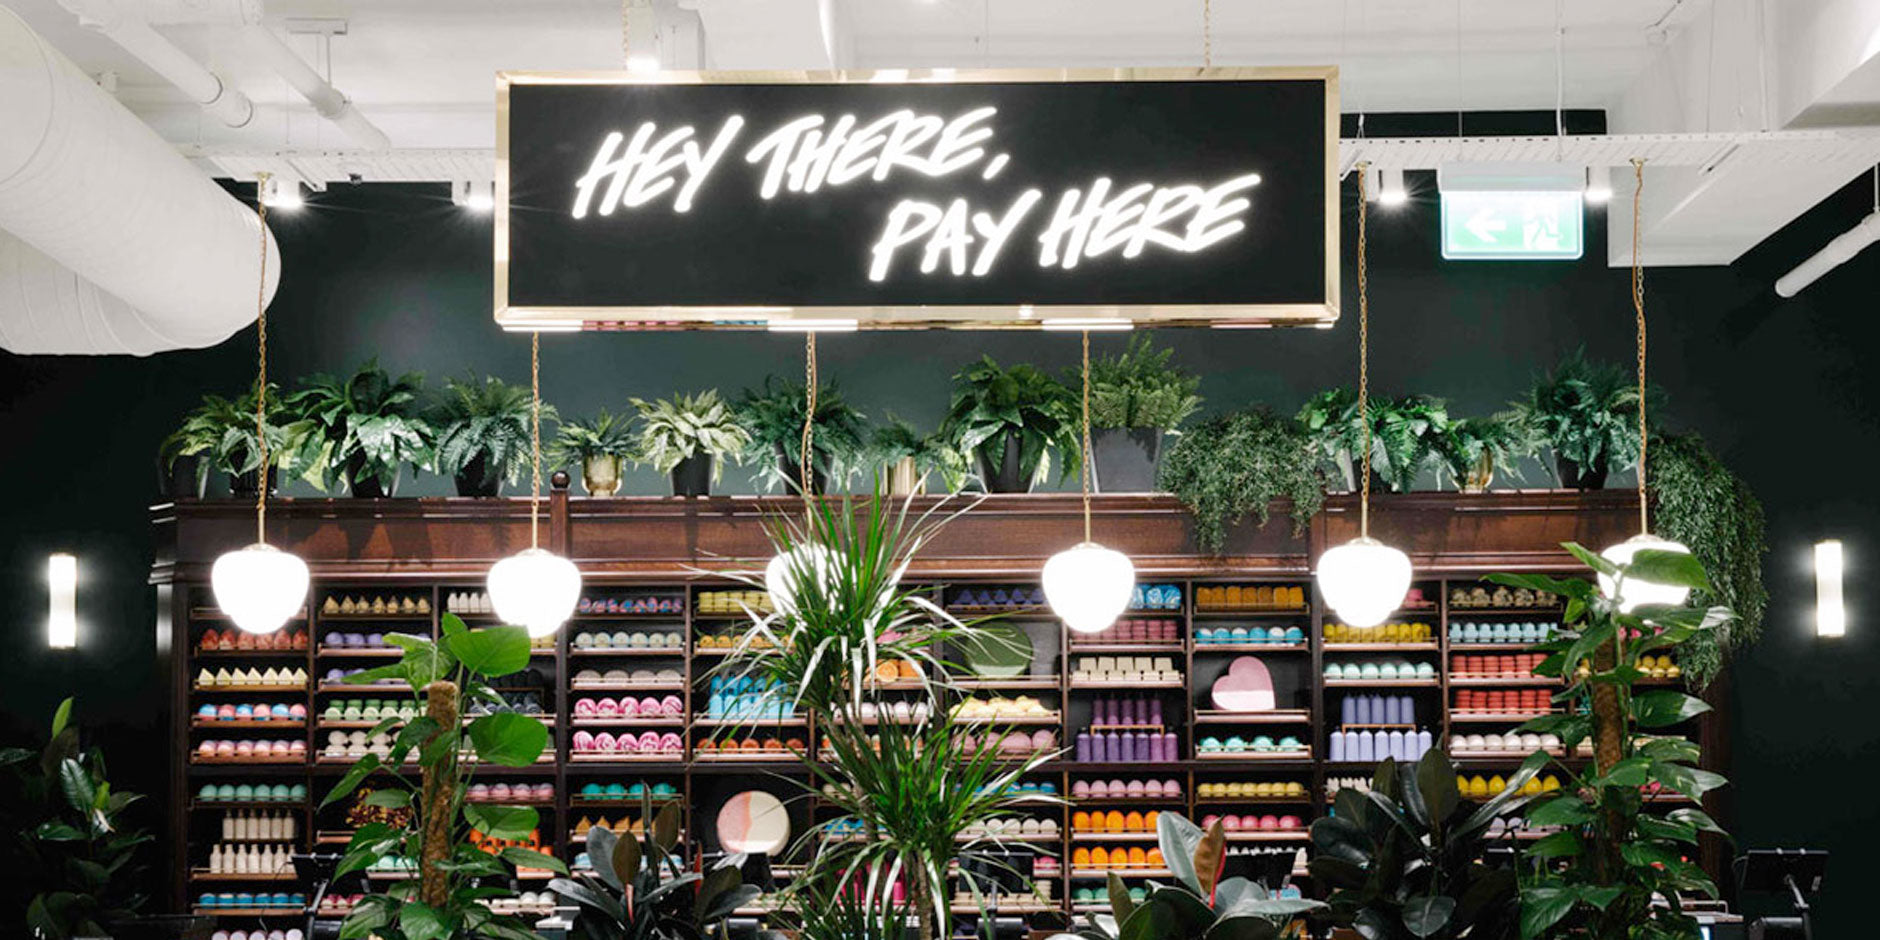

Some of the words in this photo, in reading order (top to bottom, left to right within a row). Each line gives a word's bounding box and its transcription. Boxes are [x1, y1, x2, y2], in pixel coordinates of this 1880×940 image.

[572, 114, 745, 219] HEY
[745, 106, 1011, 199] THERE,
[869, 188, 1042, 282] PAY
[1037, 173, 1262, 270] HERE
